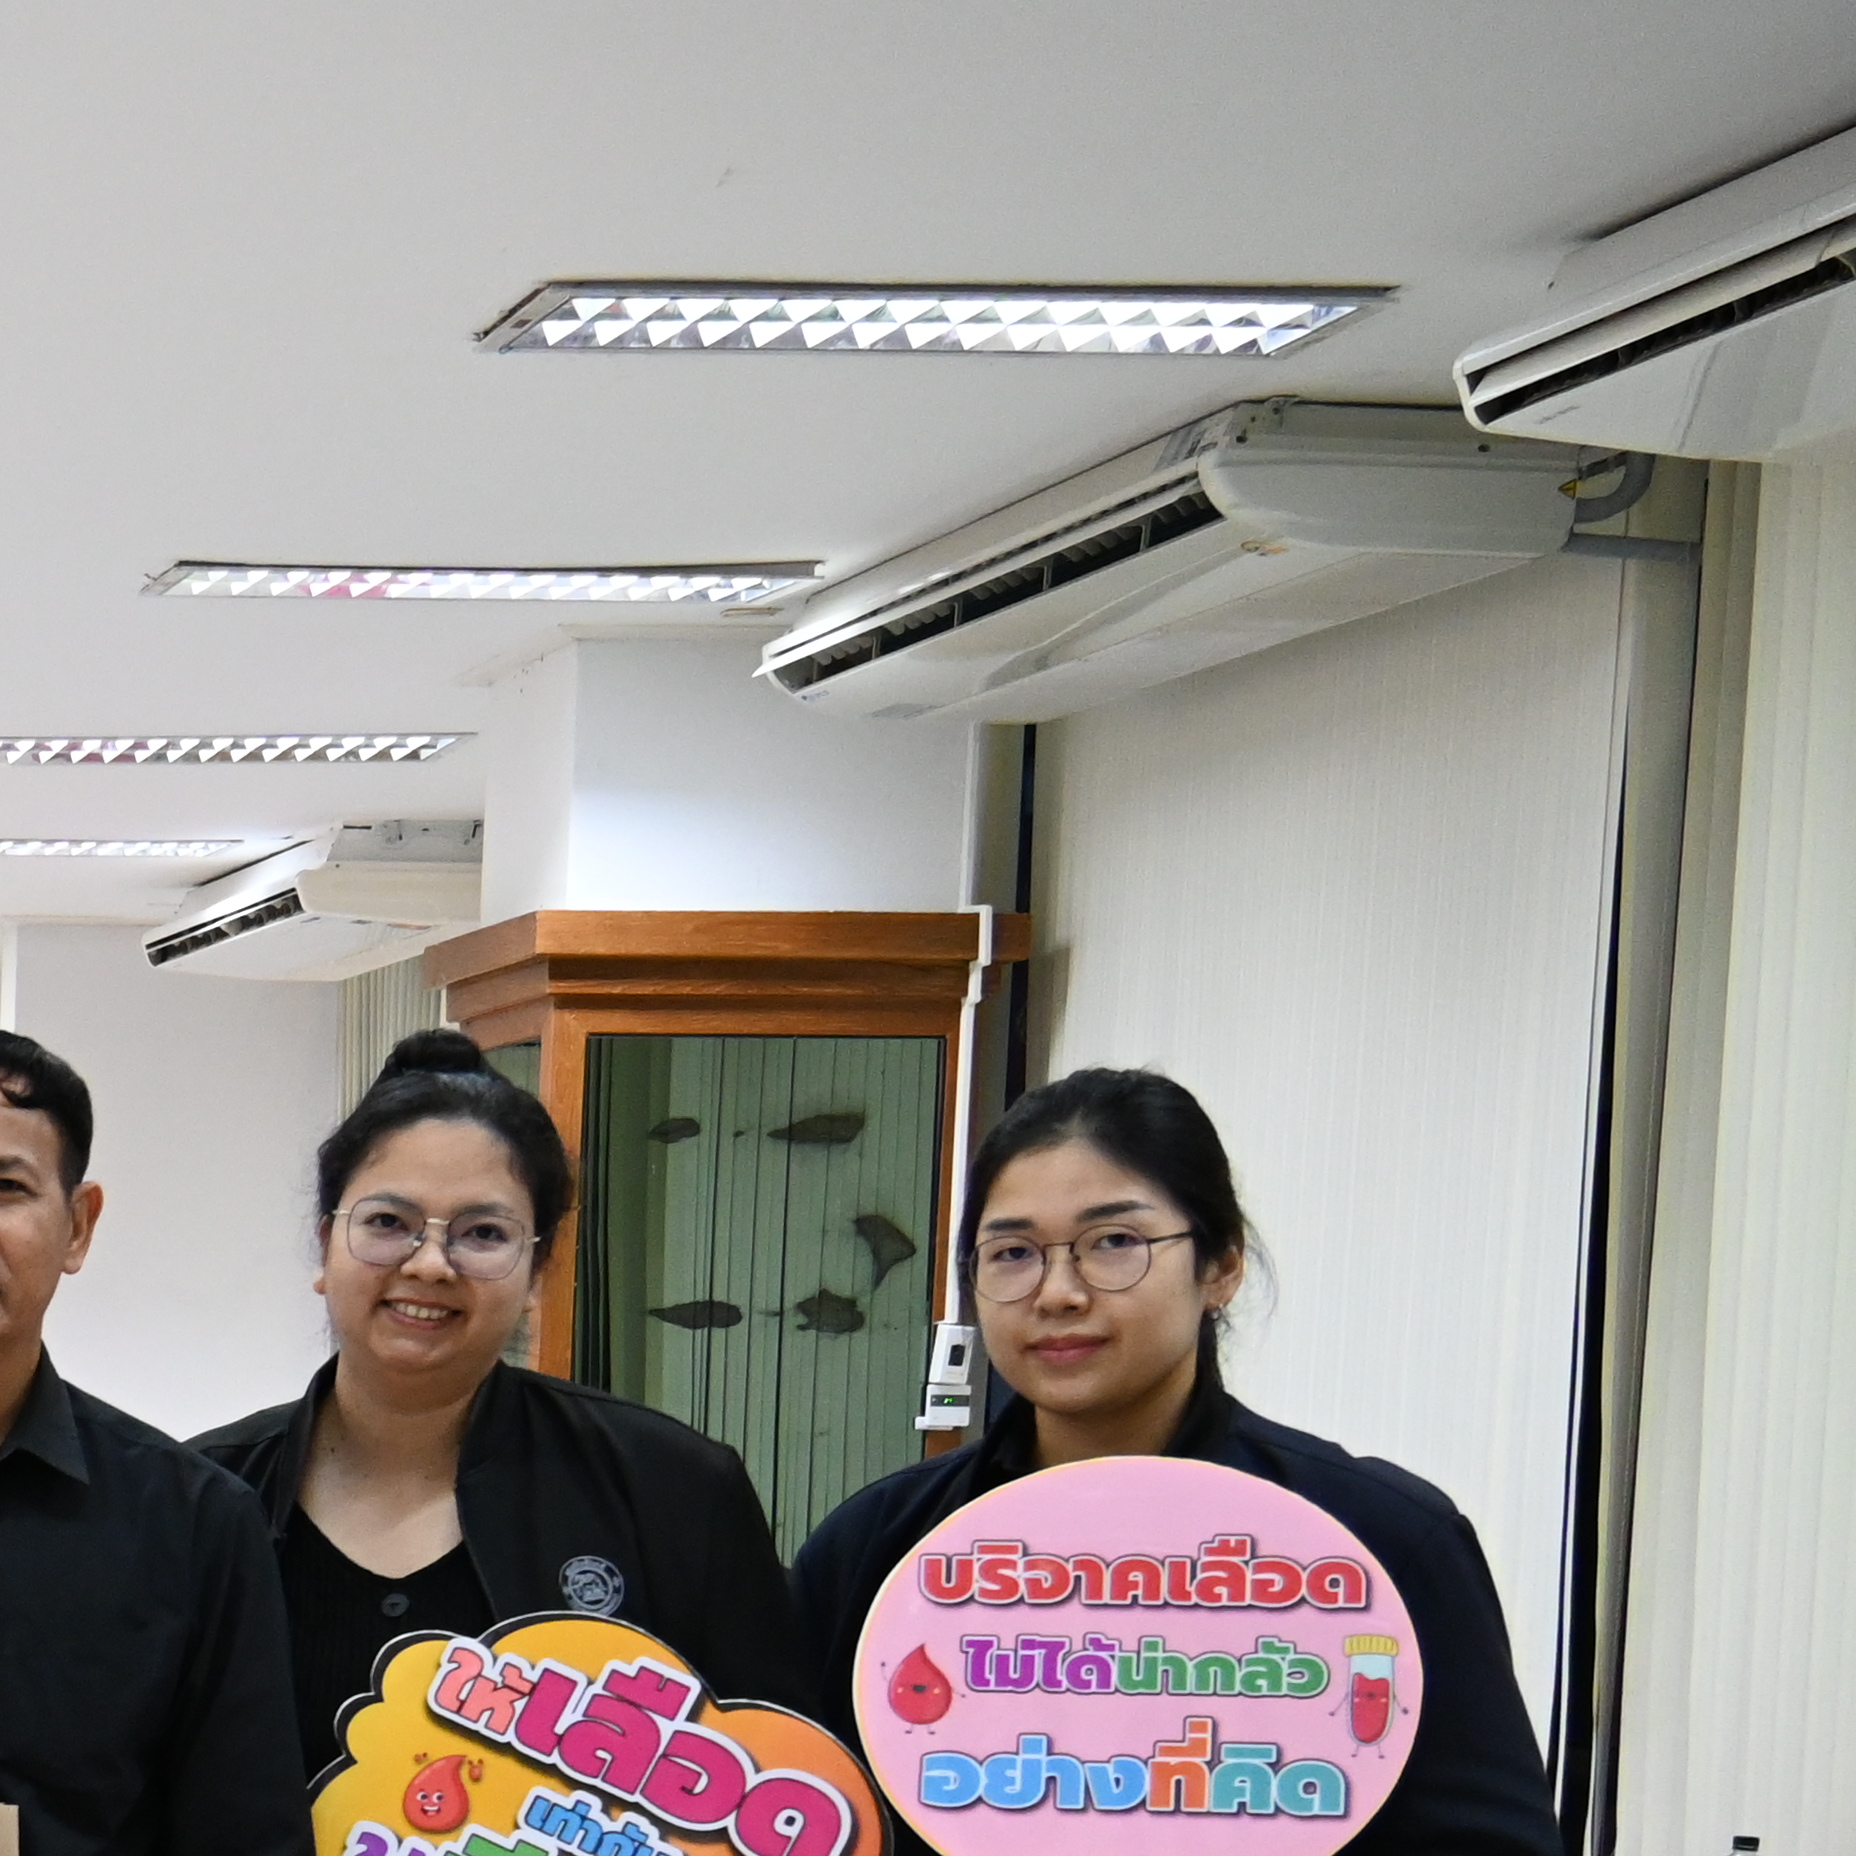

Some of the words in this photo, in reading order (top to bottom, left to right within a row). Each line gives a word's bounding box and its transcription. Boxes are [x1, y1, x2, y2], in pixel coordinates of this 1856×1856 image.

[918, 1535, 1370, 1610] บริจาคเลือด
[962, 1632, 1330, 1699] ไม่ได้น่ากลัว
[919, 1716, 1349, 1818] อย่างที่คิด
